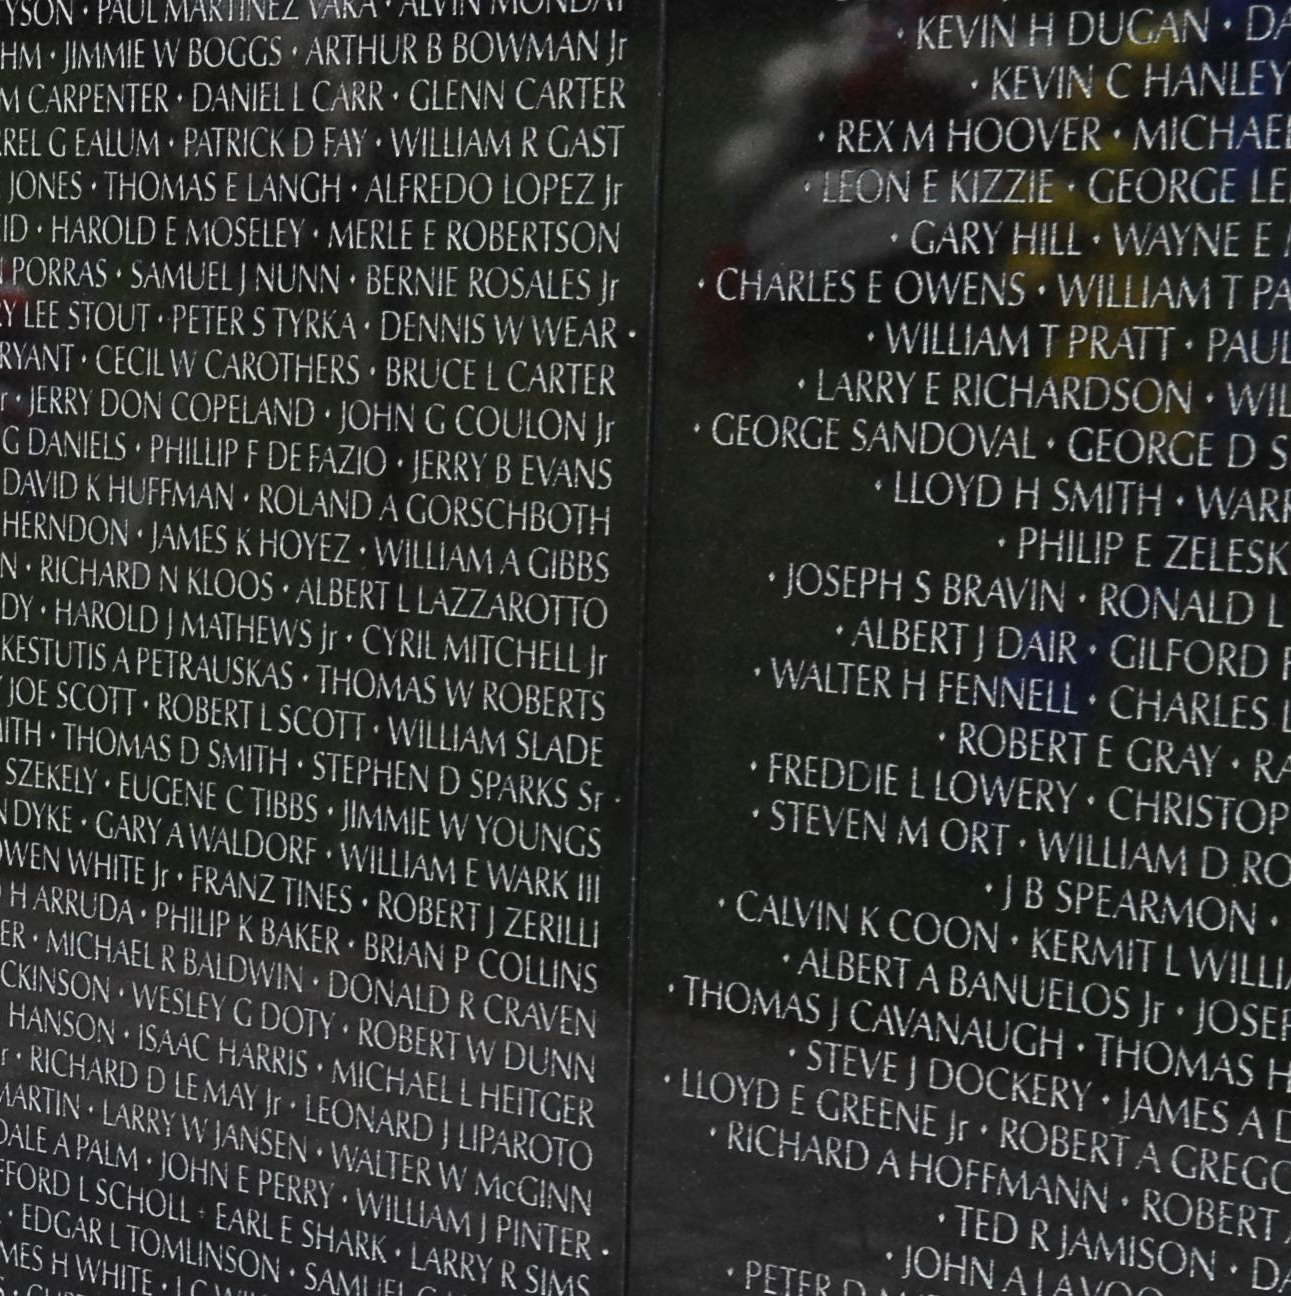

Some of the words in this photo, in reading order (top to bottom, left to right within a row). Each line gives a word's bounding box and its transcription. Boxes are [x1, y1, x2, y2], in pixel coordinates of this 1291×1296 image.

[306, 33, 417, 65] ARTHUR
[427, 33, 442, 63] B
[453, 30, 598, 63] BOWMAN
[606, 29, 627, 66] Jr
[917, 14, 1015, 49] KEVIN
[1029, 12, 1053, 47] H
[1068, 8, 1208, 45] DUGAN
[838, 120, 894, 152] REX
[903, 120, 934, 152] M
[948, 117, 1101, 152] HOOVER
[365, 173, 492, 204] ALFREDO
[504, 173, 594, 205] LOPEZ
[602, 174, 623, 210] Jr
[717, 267, 855, 303] CHARLES
[868, 270, 882, 303] E
[895, 270, 1024, 306] OWENS
[1058, 274, 1210, 309] WILLIAM
[1222, 275, 1243, 310] T
[381, 311, 484, 344] DENNIS
[494, 315, 523, 345] W
[532, 316, 617, 348] WEAR
[818, 369, 915, 403] LARRY
[926, 372, 940, 405] E
[953, 373, 1191, 414] RICHARDSON
[712, 413, 839, 450] GEORGE
[851, 419, 1036, 459] SANDOVAL
[1068, 427, 1213, 466] GEORGE
[1228, 434, 1256, 468] D
[895, 471, 1002, 507] LLOYD
[1015, 477, 1039, 510] H
[1052, 478, 1161, 516] SMITH
[771, 658, 891, 698] WALTER
[903, 669, 925, 701] H
[939, 671, 1078, 714] FENNELL
[769, 753, 897, 796] FREDDIE
[911, 767, 925, 799] L
[935, 770, 1077, 814] LOWERY
[737, 890, 848, 933] CALVIN
[861, 907, 878, 937] K
[889, 909, 998, 953] COON
[683, 975, 819, 1024] THOMAS
[828, 998, 837, 1031] J
[850, 1000, 1063, 1060] CAVANAUGH
[332, 1059, 452, 1103] MICHAEL
[461, 1079, 472, 1107] L
[481, 1083, 594, 1128] HEITGER
[683, 1068, 779, 1109] LLOYD
[791, 1085, 805, 1115] E
[817, 1089, 937, 1137] GREENE
[945, 1111, 969, 1144] Jr
[1000, 1117, 1130, 1167] ROBERT
[1135, 1142, 1161, 1173] A
